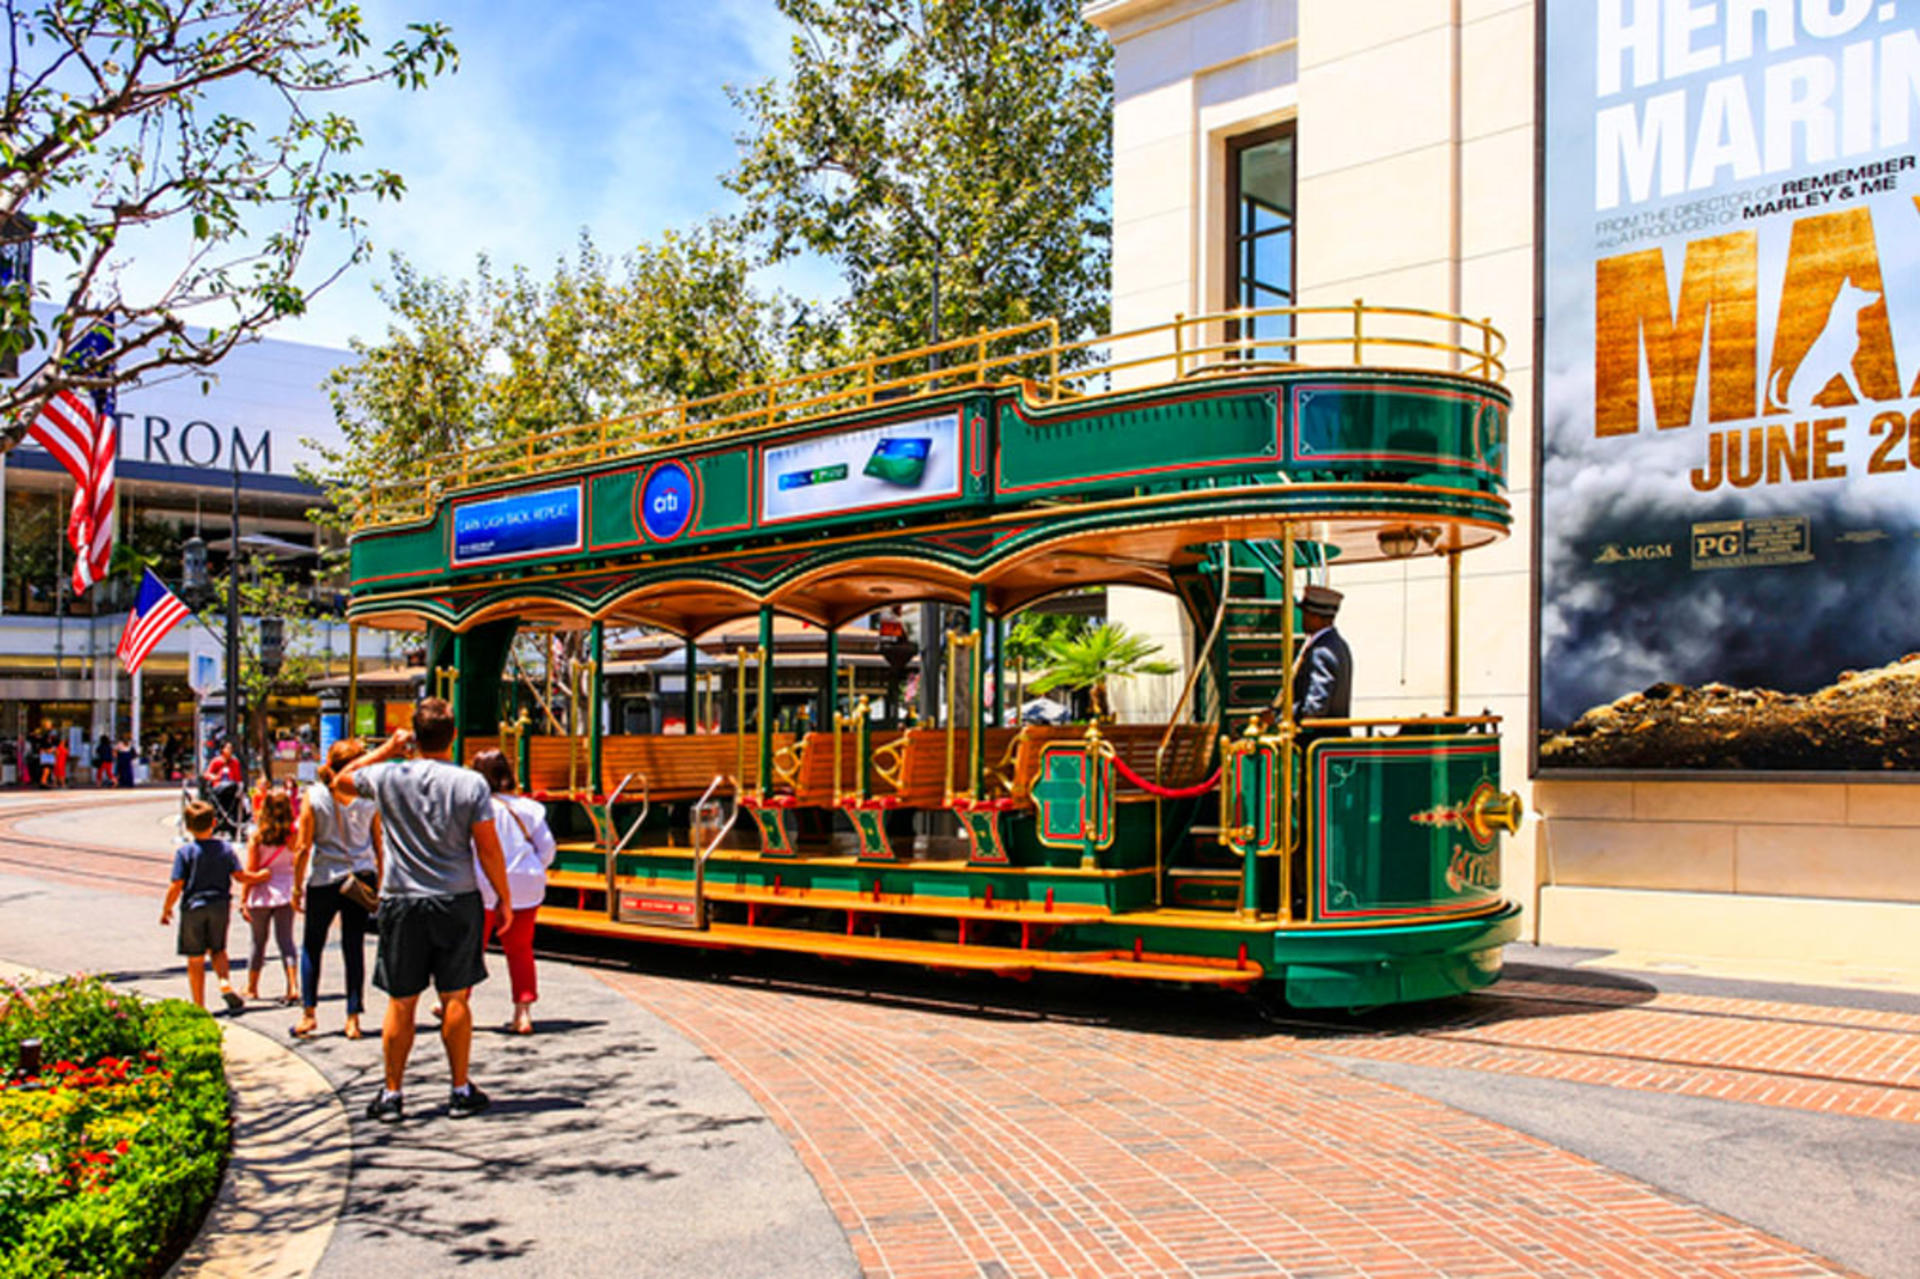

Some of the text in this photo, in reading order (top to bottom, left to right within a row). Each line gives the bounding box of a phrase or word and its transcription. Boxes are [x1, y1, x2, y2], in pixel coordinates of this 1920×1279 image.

[1595, 155, 1916, 235] FROM THE DIRECTOR OF REMEMBER
[1631, 213, 1716, 241] PRODUCER
[1718, 209, 1739, 225] OF
[1743, 188, 1833, 219] MARLEY
[1838, 185, 1854, 201] &
[1860, 175, 1897, 195] ME
[1595, 195, 1920, 439] MA
[1690, 416, 1847, 492] JUNE
[1627, 544, 1672, 560] MGM
[1696, 534, 1738, 558] PG
